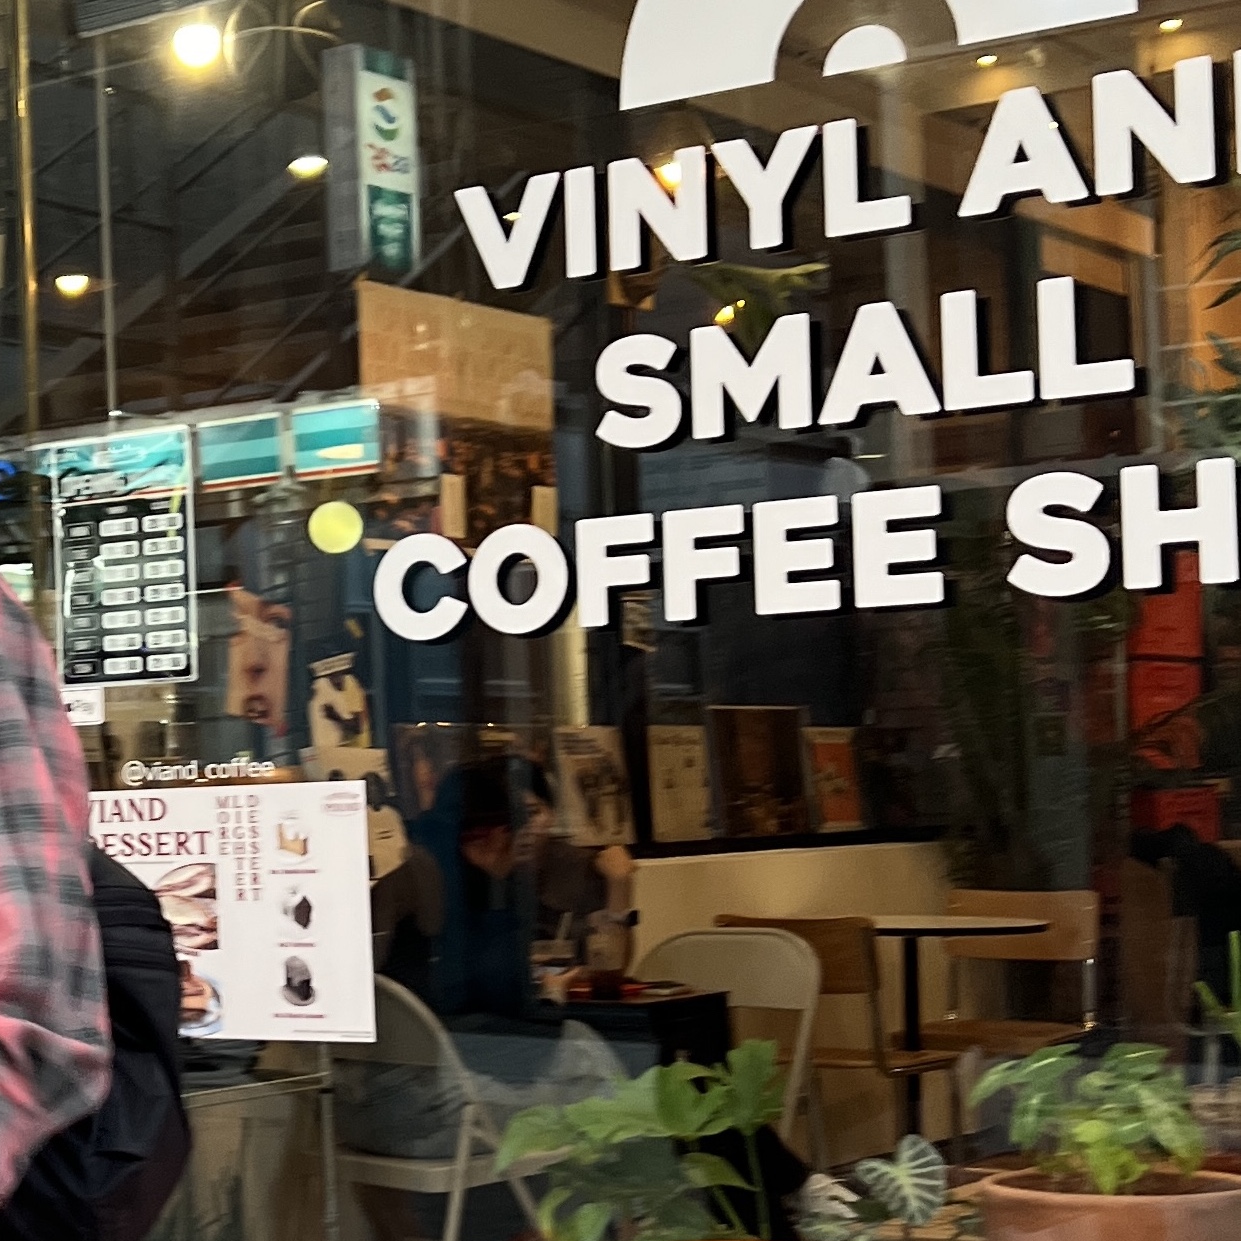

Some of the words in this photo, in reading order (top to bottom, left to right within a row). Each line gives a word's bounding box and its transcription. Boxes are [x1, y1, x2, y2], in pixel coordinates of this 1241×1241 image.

[454, 118, 912, 289] VINYL
[959, 52, 1241, 217] AN
[594, 276, 1136, 450] SMALL
[373, 484, 945, 641] COFFEE
[99, 830, 211, 857] ESSERT
[120, 757, 275, 786] @viand_coffee
